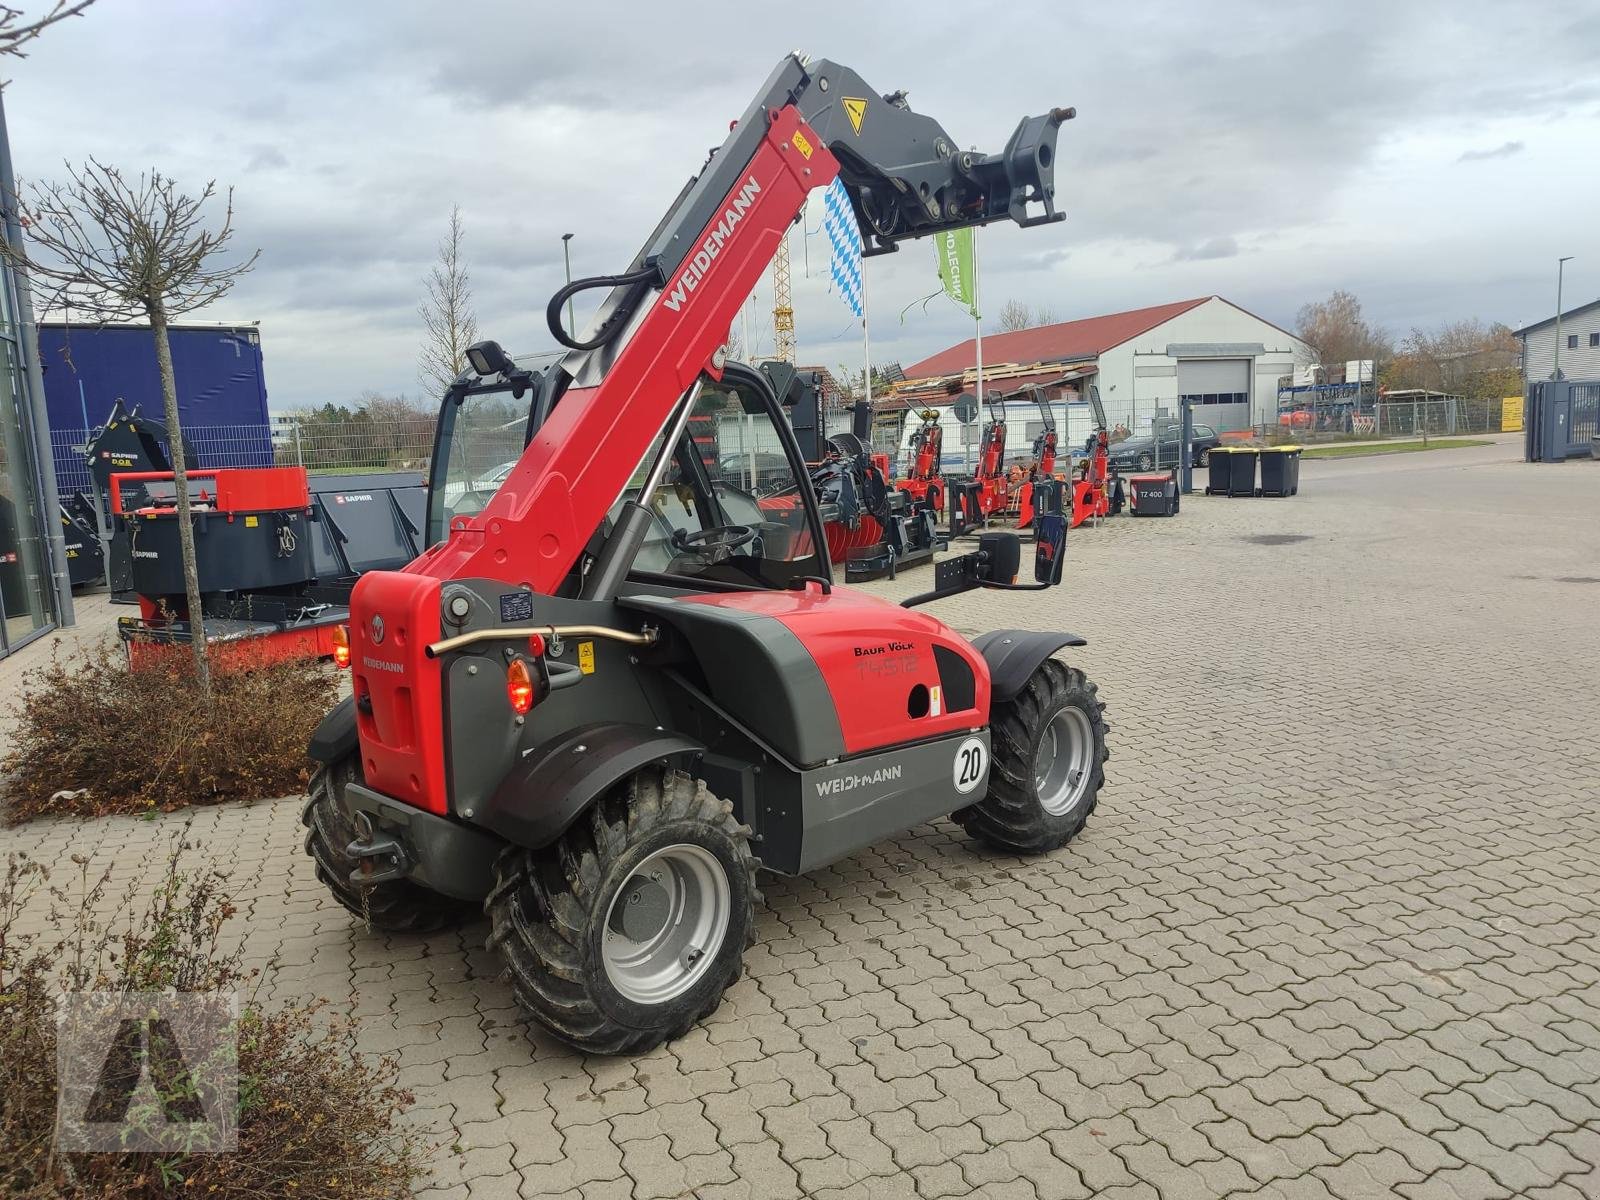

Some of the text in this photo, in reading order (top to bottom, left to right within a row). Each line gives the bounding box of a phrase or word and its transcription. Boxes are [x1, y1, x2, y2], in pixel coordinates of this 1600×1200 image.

[663, 175, 762, 312] WEIDEMANN
[345, 494, 373, 502] SAPHIR
[363, 656, 404, 673] WEIDEMANN
[959, 746, 980, 785] 20
